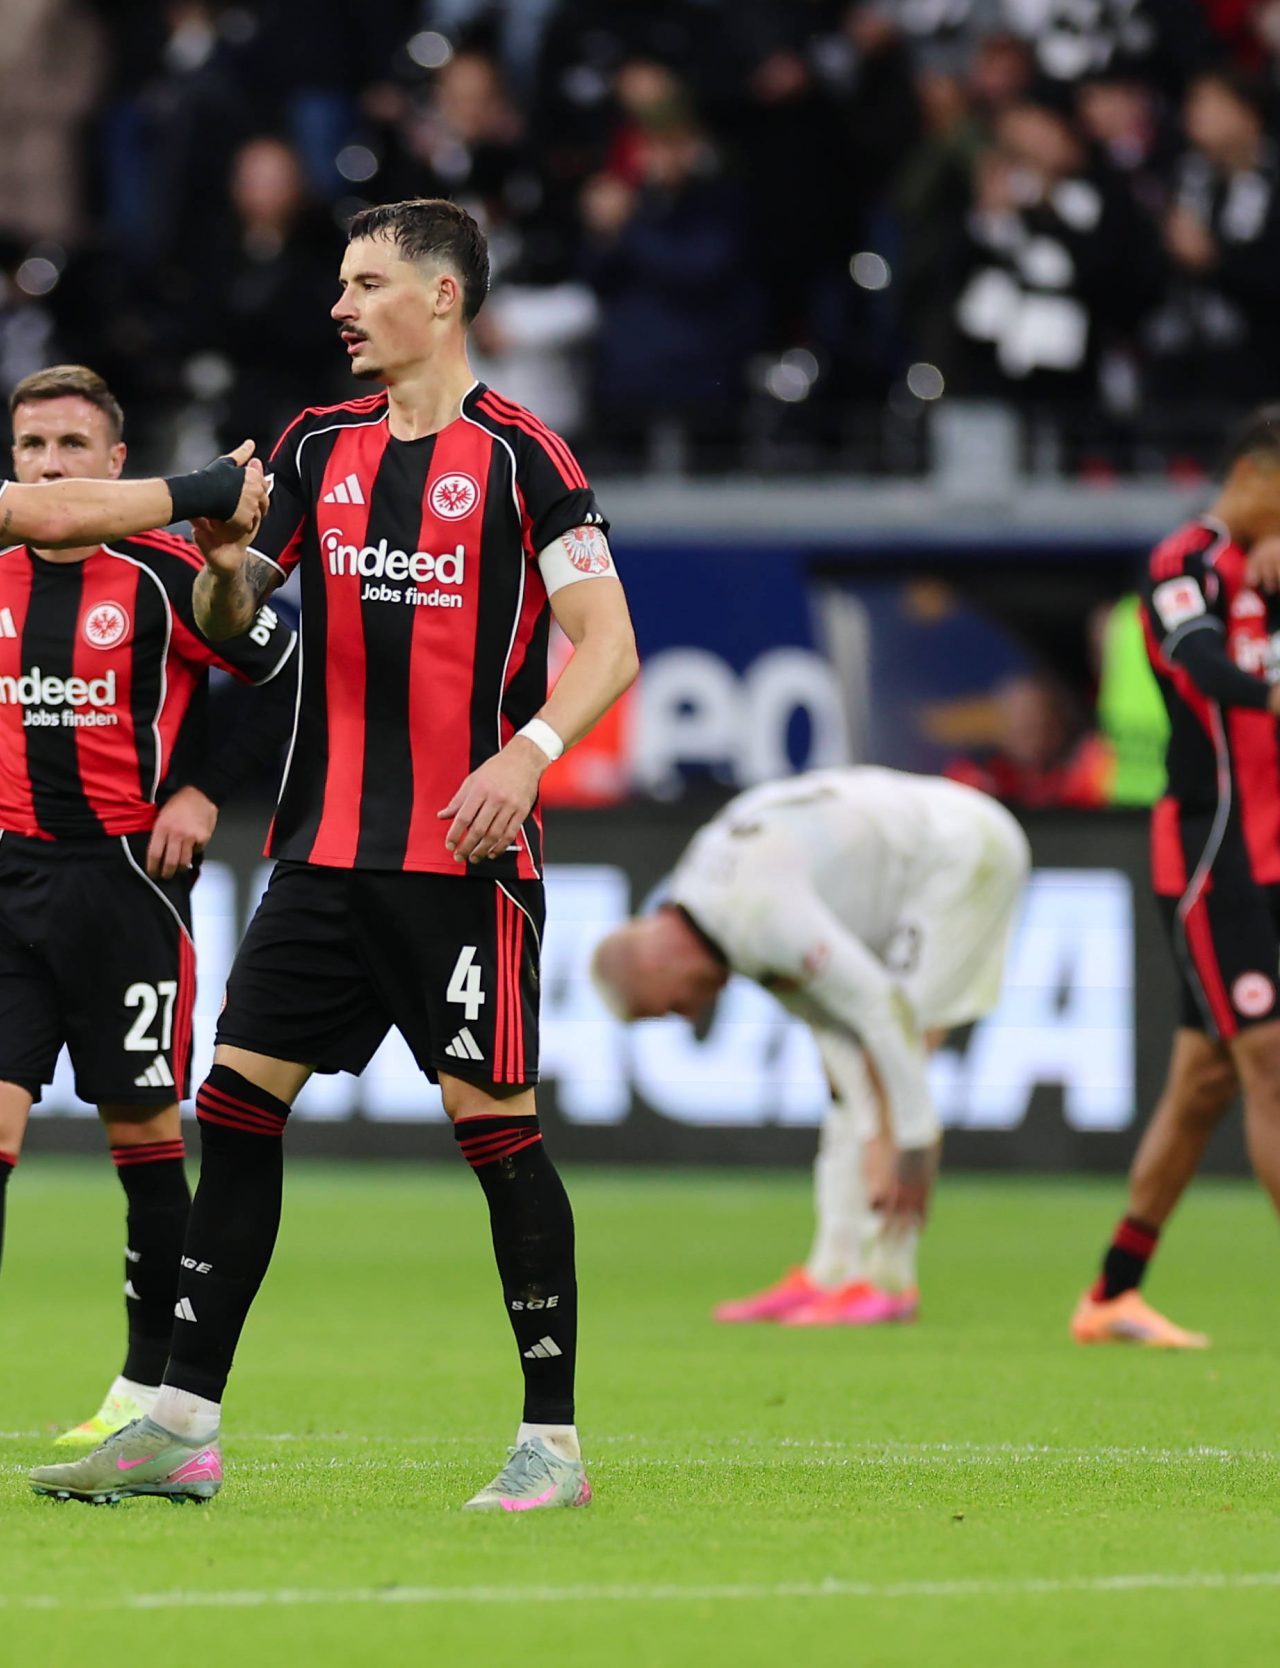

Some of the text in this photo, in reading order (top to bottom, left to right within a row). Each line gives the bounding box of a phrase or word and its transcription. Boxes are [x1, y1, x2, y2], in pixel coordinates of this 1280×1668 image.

[321, 528, 465, 585] indeed
[361, 583, 463, 608] Jobs finden
[23, 709, 118, 728] Jobs finden
[446, 945, 486, 1021] 4
[123, 980, 178, 1052] 27
[180, 1254, 213, 1275] GE
[511, 1295, 560, 1311] SGE
